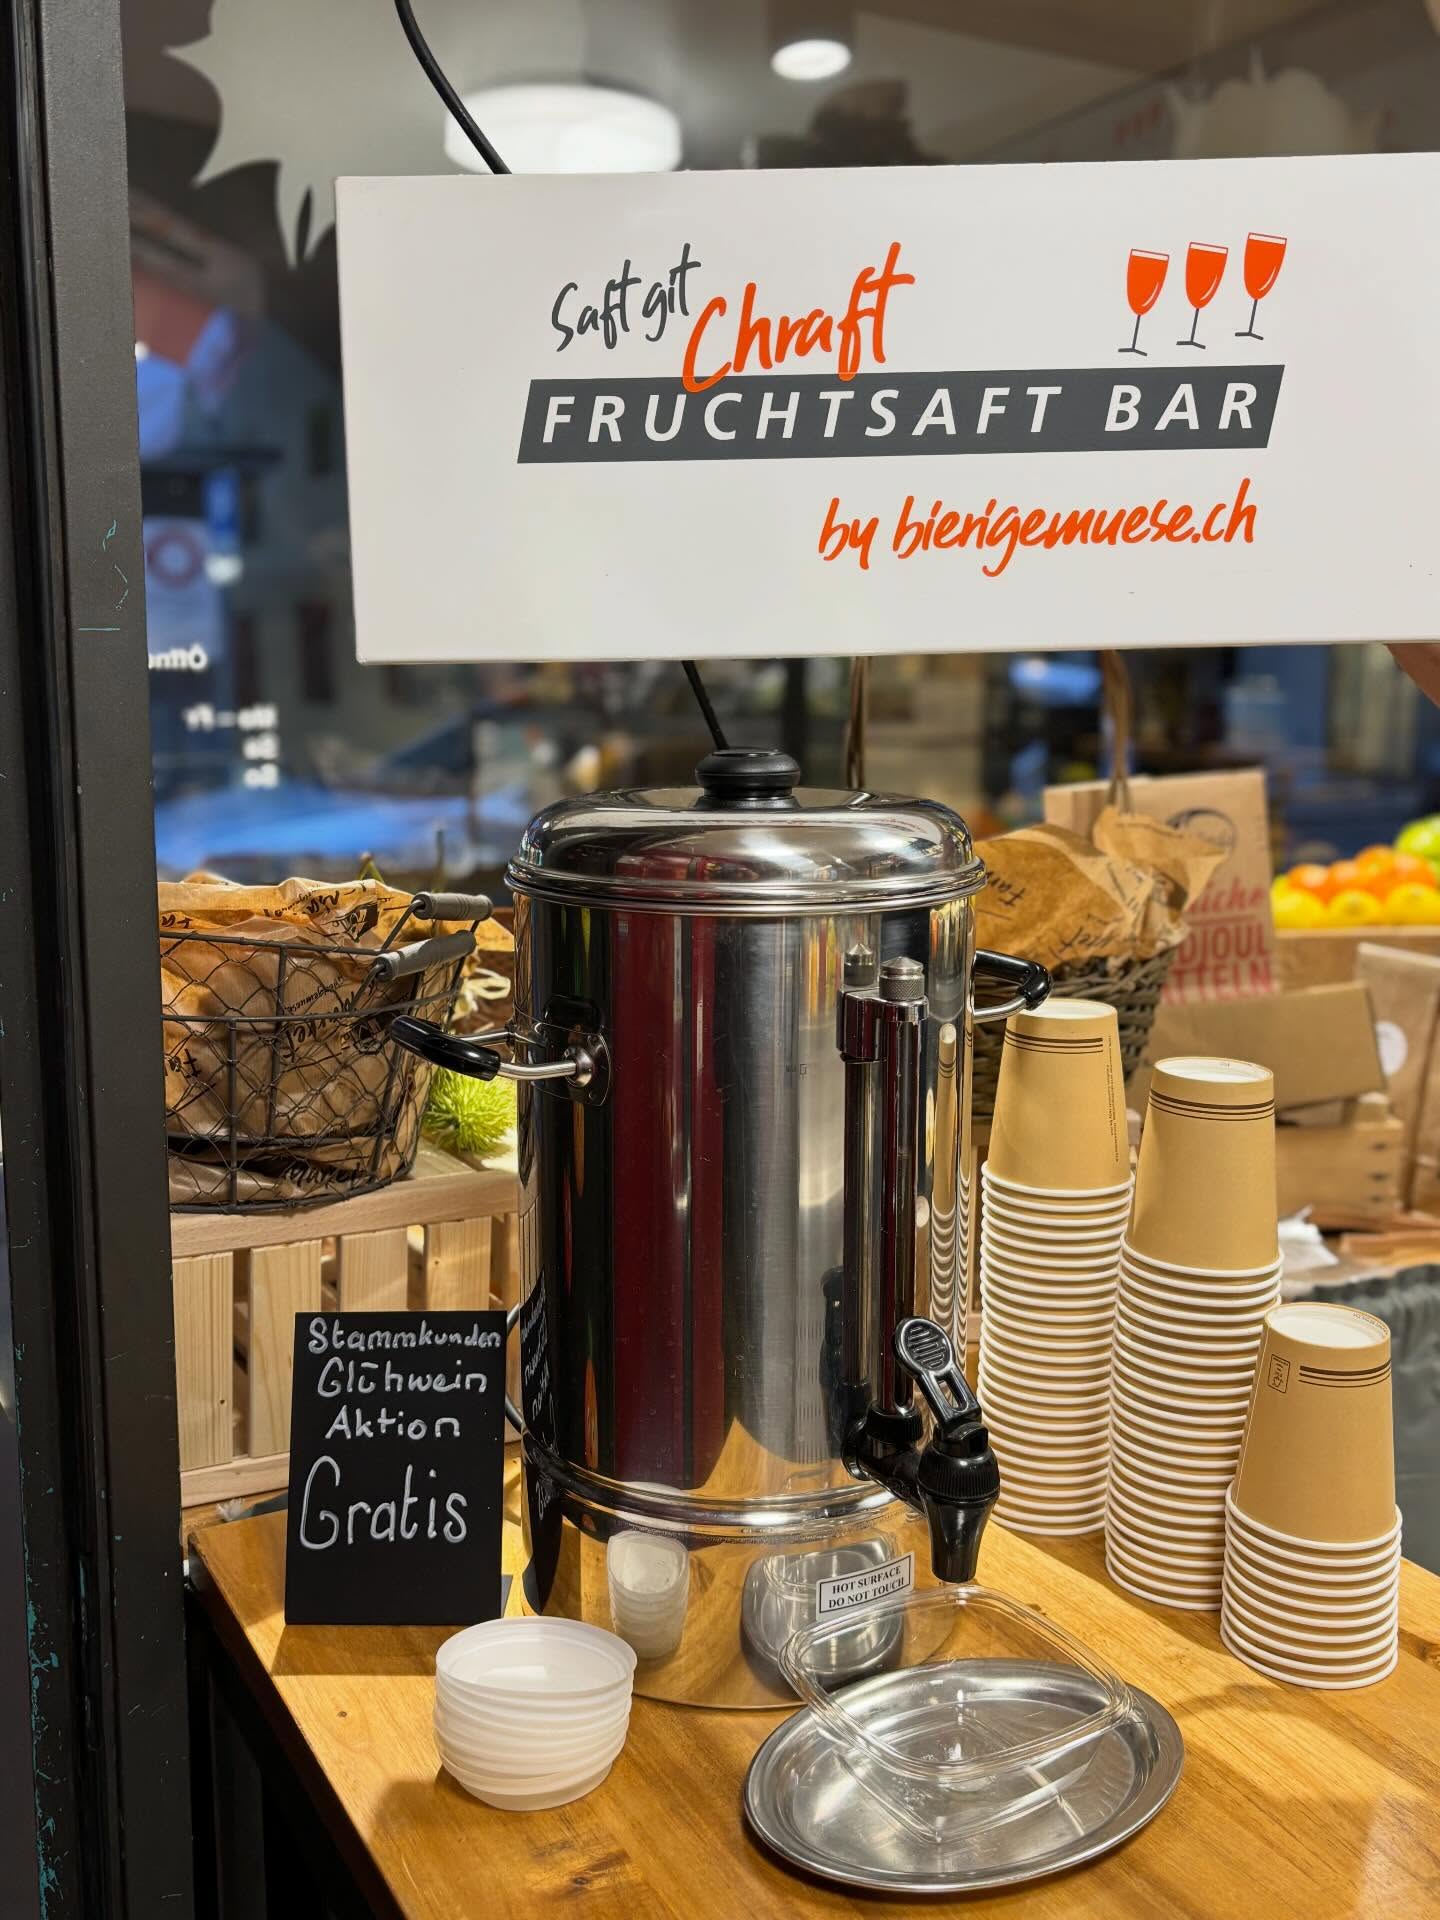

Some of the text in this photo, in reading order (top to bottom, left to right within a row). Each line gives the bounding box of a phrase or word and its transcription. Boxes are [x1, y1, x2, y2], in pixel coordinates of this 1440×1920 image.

[552, 241, 916, 393] Saft git Chraft
[541, 382, 1258, 444] FRUCHTSAFT BAR
[817, 478, 1258, 578] by bierigemuese.ch
[308, 1317, 501, 1354] Stammkunden
[324, 1404, 461, 1440] Aktion
[299, 1455, 468, 1550] Gratis
[828, 1577, 905, 1609] DO NOT TOUCH
[832, 1565, 902, 1595] HOT SURFACE
